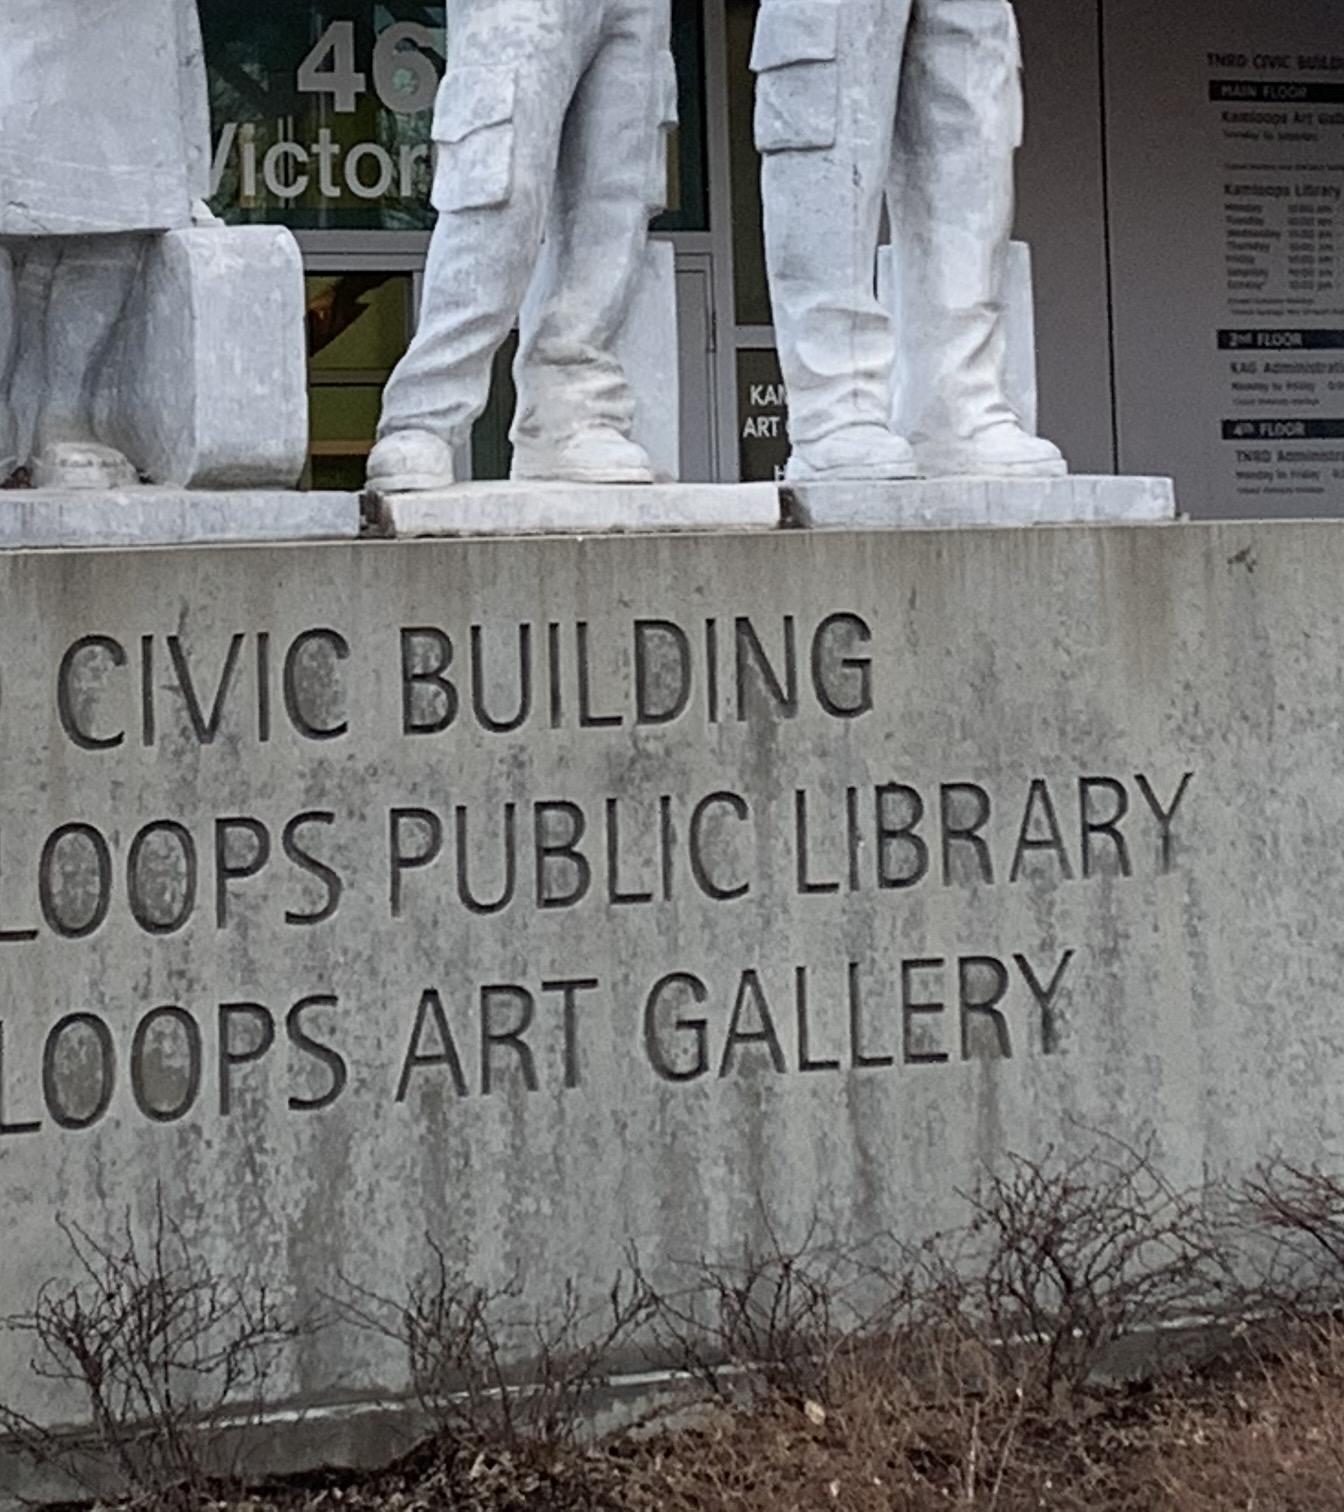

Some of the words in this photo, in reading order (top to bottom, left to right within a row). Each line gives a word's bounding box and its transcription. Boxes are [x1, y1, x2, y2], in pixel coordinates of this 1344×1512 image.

[297, 20, 439, 113] 46
[1257, 332, 1303, 346] FLOOR
[742, 416, 781, 439] ART
[1259, 421, 1306, 436] FLOOR
[57, 628, 350, 751] CIVIC
[400, 612, 874, 736] BUILDING
[389, 790, 750, 917] PUBLIC
[795, 772, 1194, 896] LIBRARY
[395, 978, 599, 1102] ART
[643, 948, 1076, 1083] GALLERY
